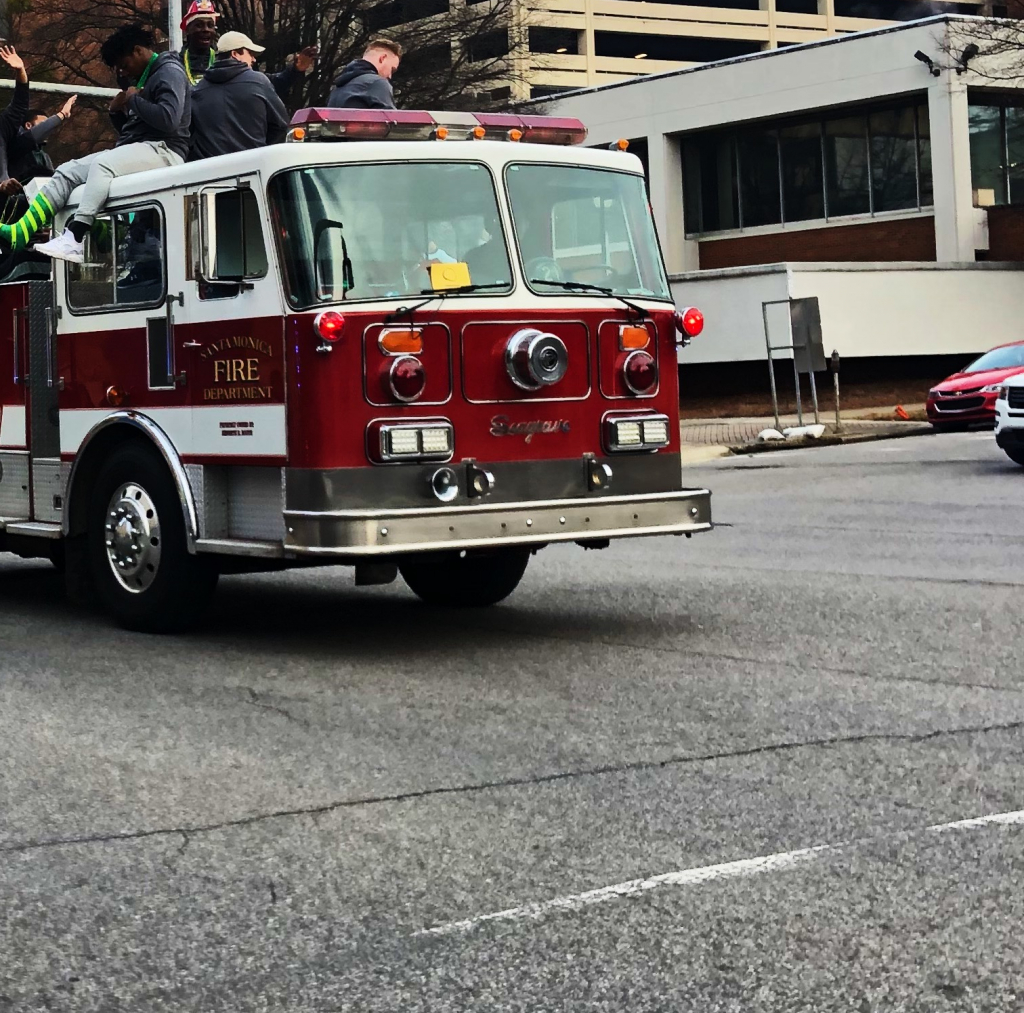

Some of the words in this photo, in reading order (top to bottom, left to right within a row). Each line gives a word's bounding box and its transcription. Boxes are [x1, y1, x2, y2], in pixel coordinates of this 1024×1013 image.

[232, 335, 273, 357] MONICA
[213, 358, 260, 382] FIRE
[203, 386, 273, 400] DEPARTMENT
